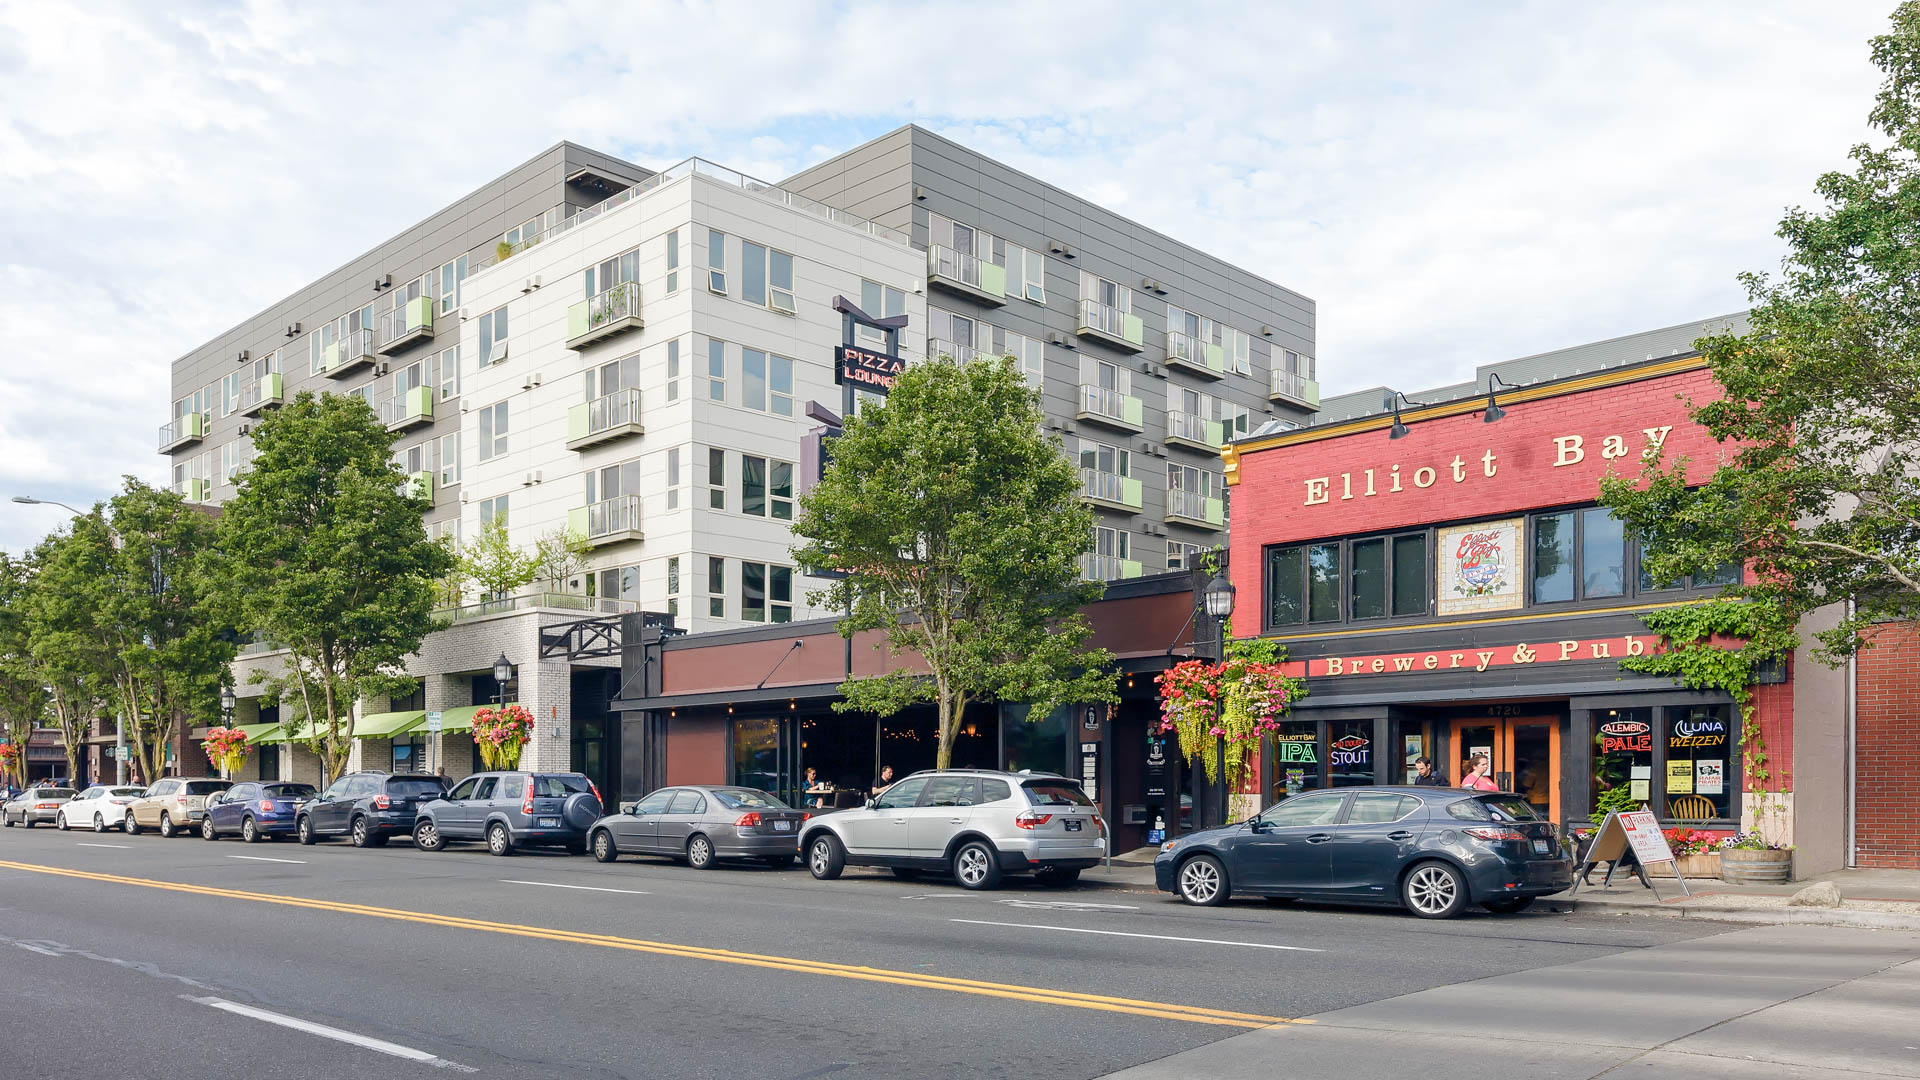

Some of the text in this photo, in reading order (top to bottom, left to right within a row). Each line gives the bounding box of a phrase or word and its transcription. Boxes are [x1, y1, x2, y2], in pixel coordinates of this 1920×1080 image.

[844, 348, 904, 373] PIZZA
[1303, 425, 1673, 506] Elliott Bay
[1456, 528, 1503, 559] Elliott
[1462, 542, 1501, 569] Bay
[1326, 635, 1645, 676] Brewery & Pub
[1487, 705, 1521, 716] 4720
[1605, 722, 1648, 733] ALEMBIC
[1684, 721, 1724, 732] LUNA
[1303, 733, 1316, 741] BAY
[1602, 734, 1651, 753] PALE
[1670, 735, 1725, 747] WEIZEN
[1280, 743, 1318, 763] IPA
[1330, 749, 1370, 766] STOUT
[1622, 814, 1656, 829] NO PARKING
